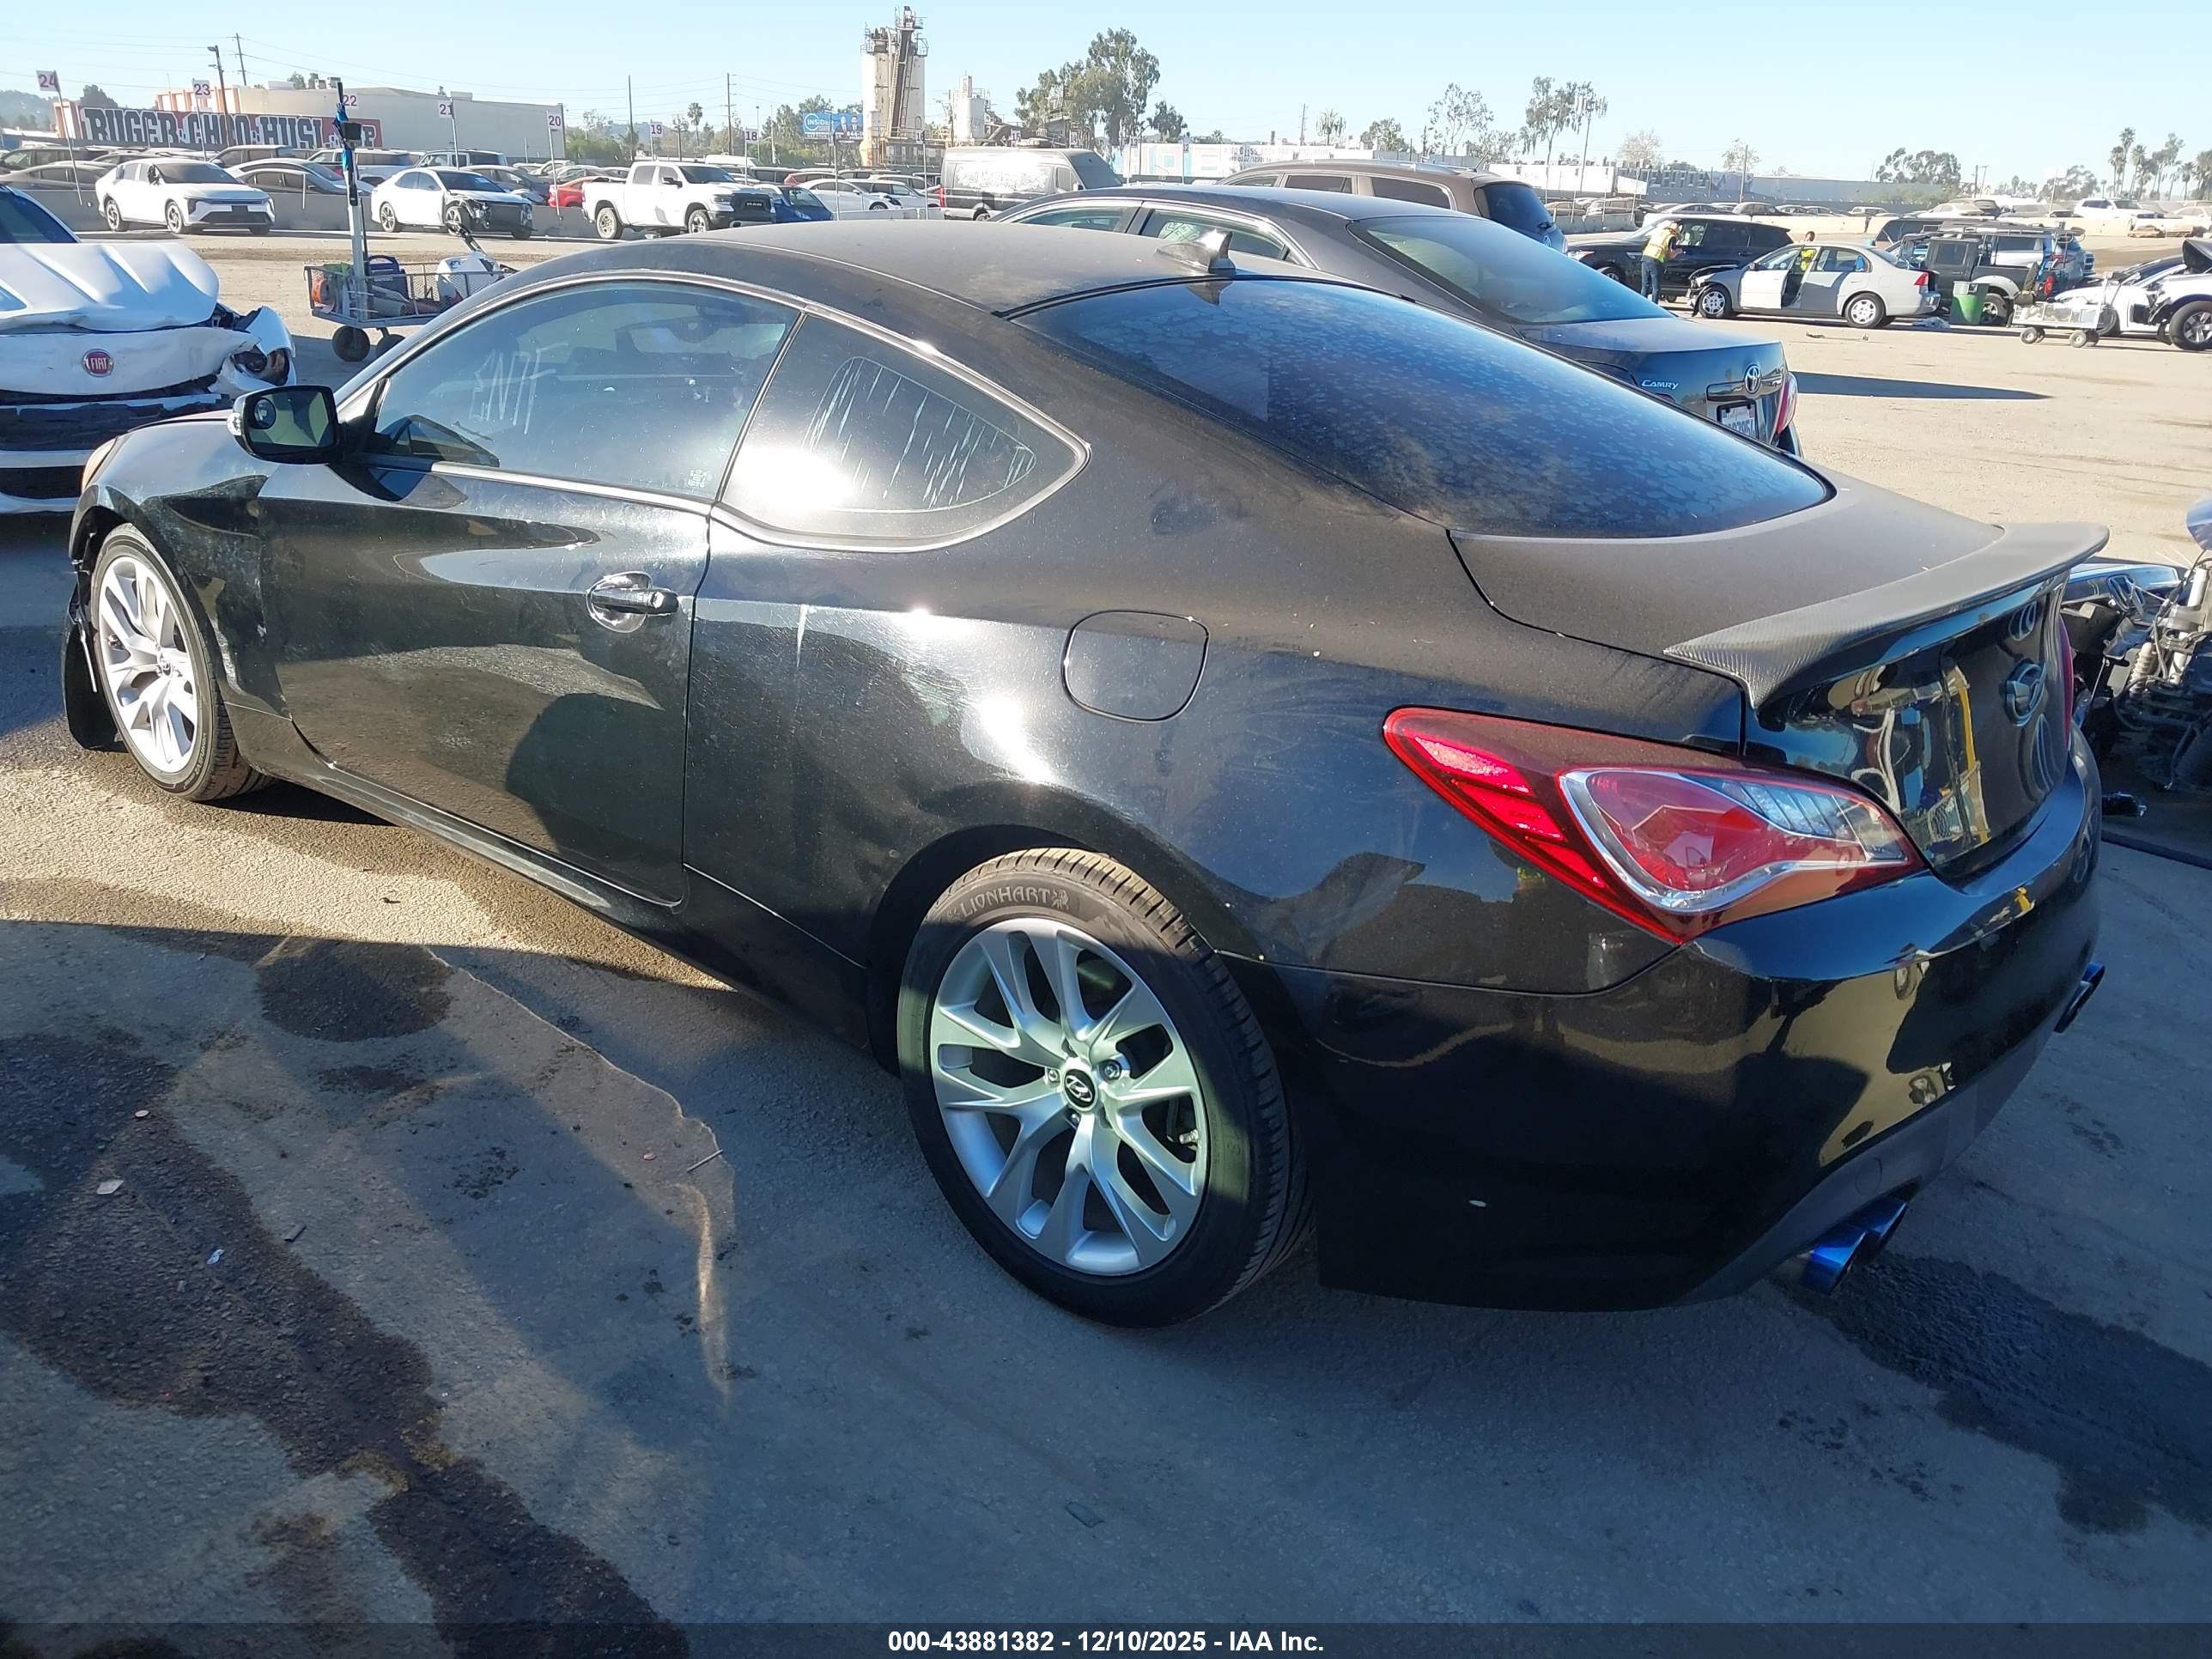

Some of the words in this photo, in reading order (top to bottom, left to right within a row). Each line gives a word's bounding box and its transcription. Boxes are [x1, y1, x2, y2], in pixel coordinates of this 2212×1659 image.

[39, 74, 57, 88] 24
[194, 83, 210, 95] 23
[343, 94, 357, 106] 22
[439, 104, 453, 115] 21
[549, 115, 561, 126] 20
[651, 125, 662, 135] 19
[745, 131, 757, 141] 18
[90, 357, 107, 370] FIAT
[960, 885, 1050, 917] LIONHART
